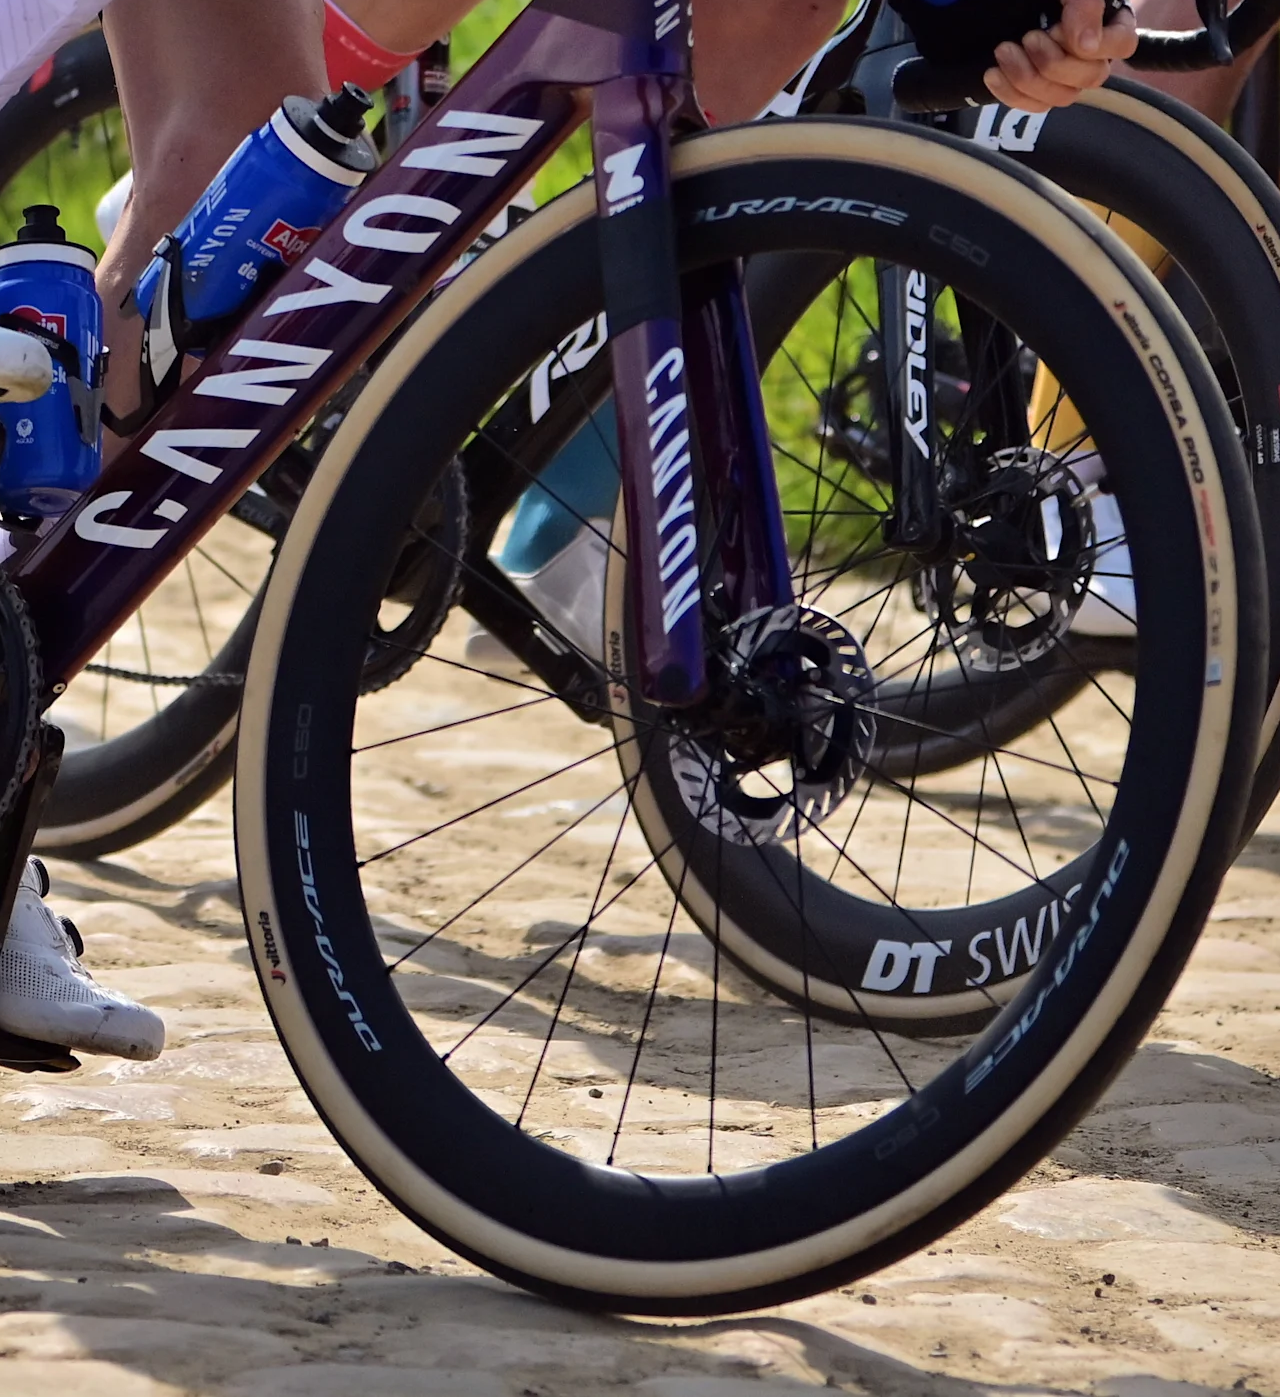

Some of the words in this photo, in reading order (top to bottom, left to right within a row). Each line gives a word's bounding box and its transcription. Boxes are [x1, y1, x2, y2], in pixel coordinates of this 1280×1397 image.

[75, 110, 545, 549] CANYON
[237, 261, 258, 283] de
[905, 269, 930, 460] RIDLEY
[645, 346, 701, 636] CANYON
[258, 910, 281, 970] vittoria
[294, 810, 384, 1053] DURA-ACE
[860, 938, 953, 994] DT
[963, 838, 1131, 1095] DURA-ACE
